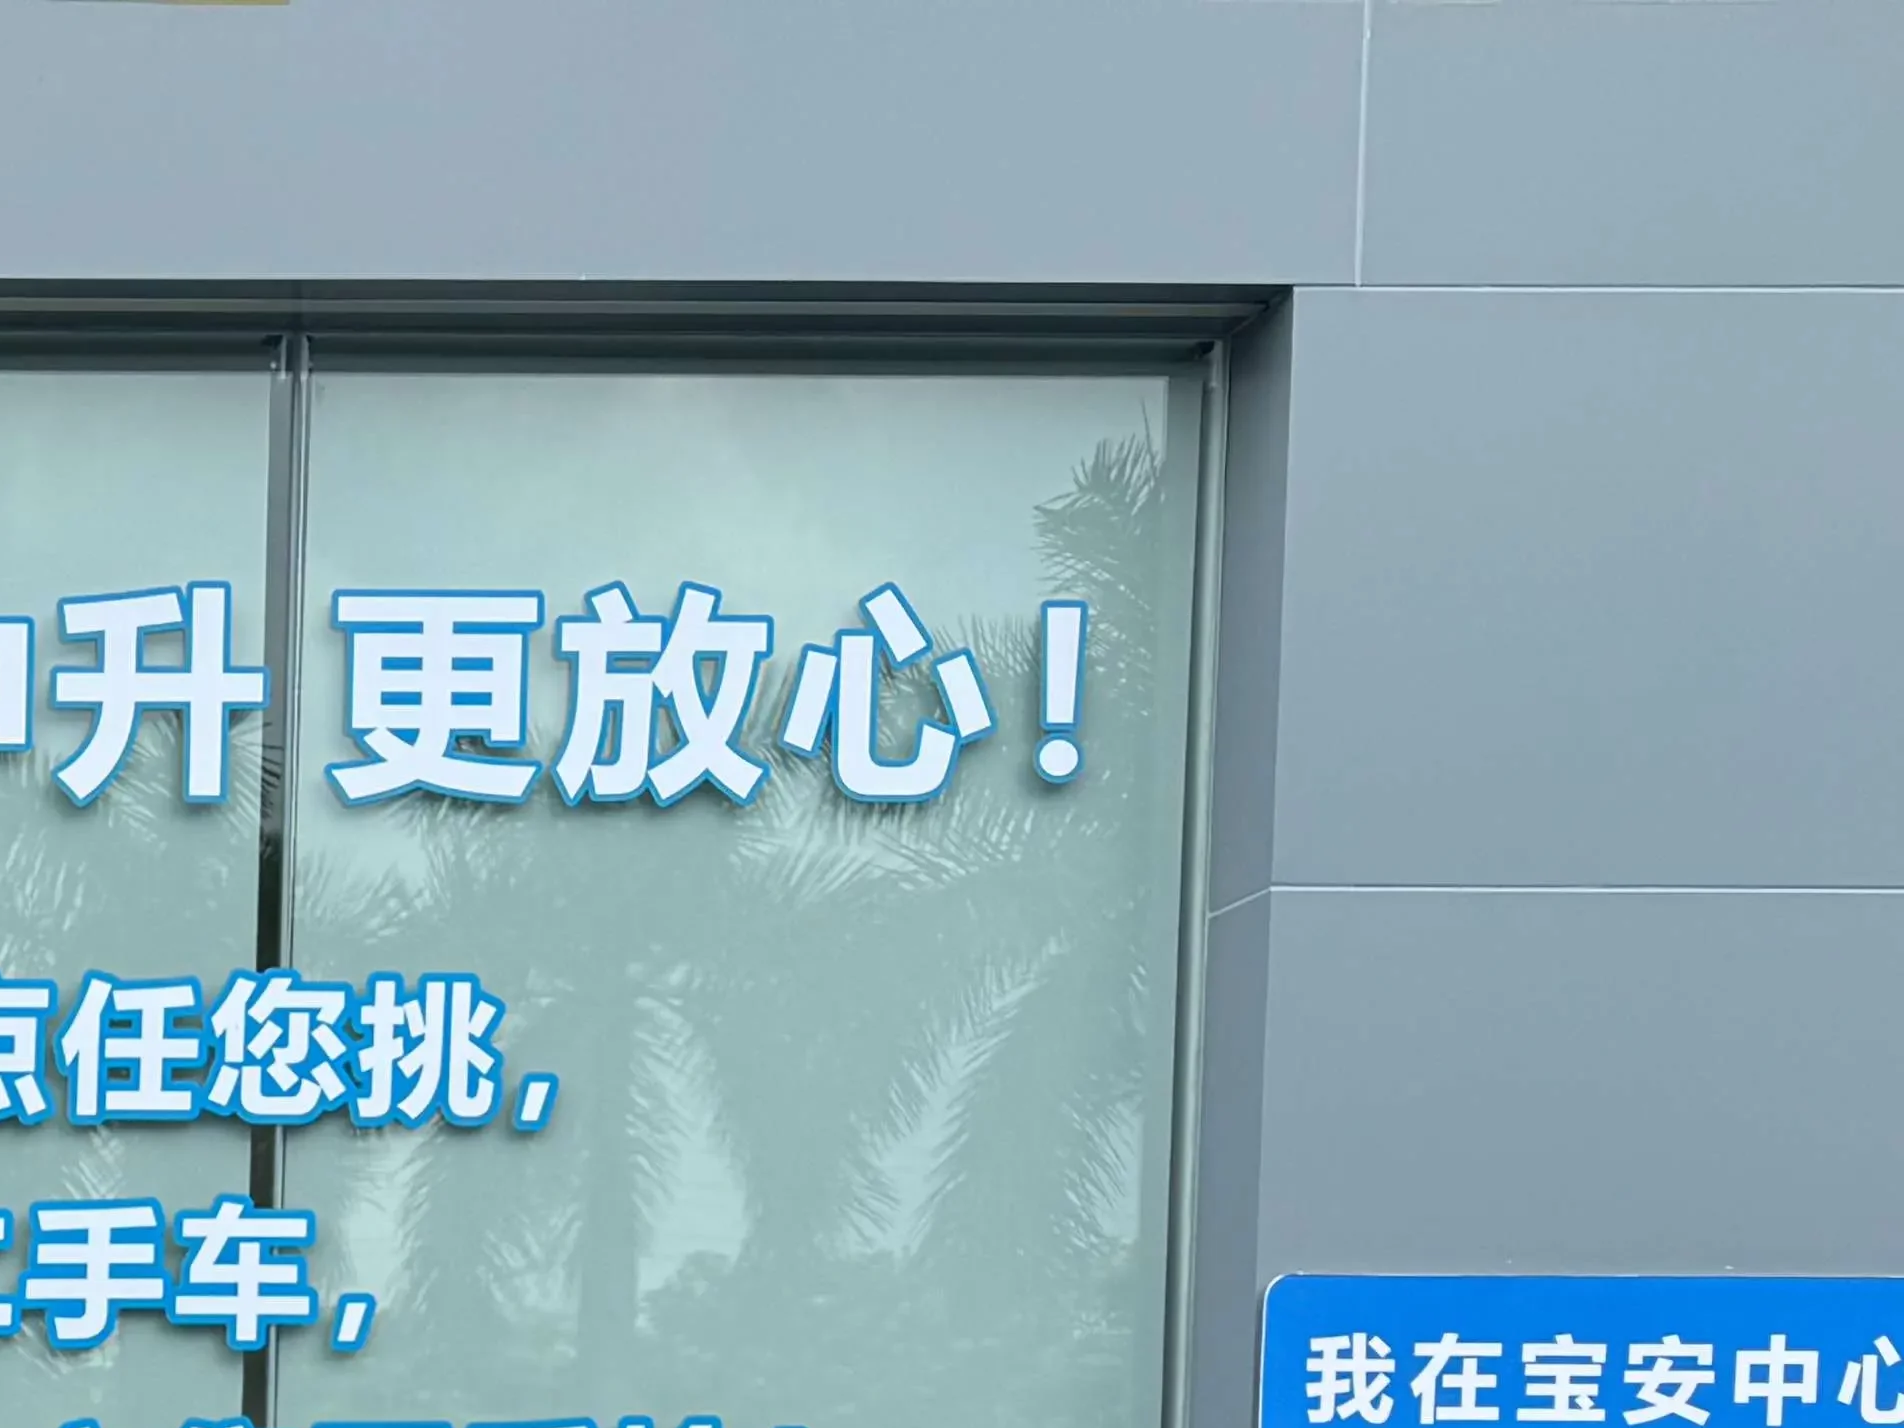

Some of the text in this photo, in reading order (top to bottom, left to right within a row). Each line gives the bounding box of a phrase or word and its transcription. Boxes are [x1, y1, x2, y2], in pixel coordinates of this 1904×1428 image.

[334, 588, 1082, 799] 更放心！
[1305, 1332, 1904, 1427] 我在宝安中心
